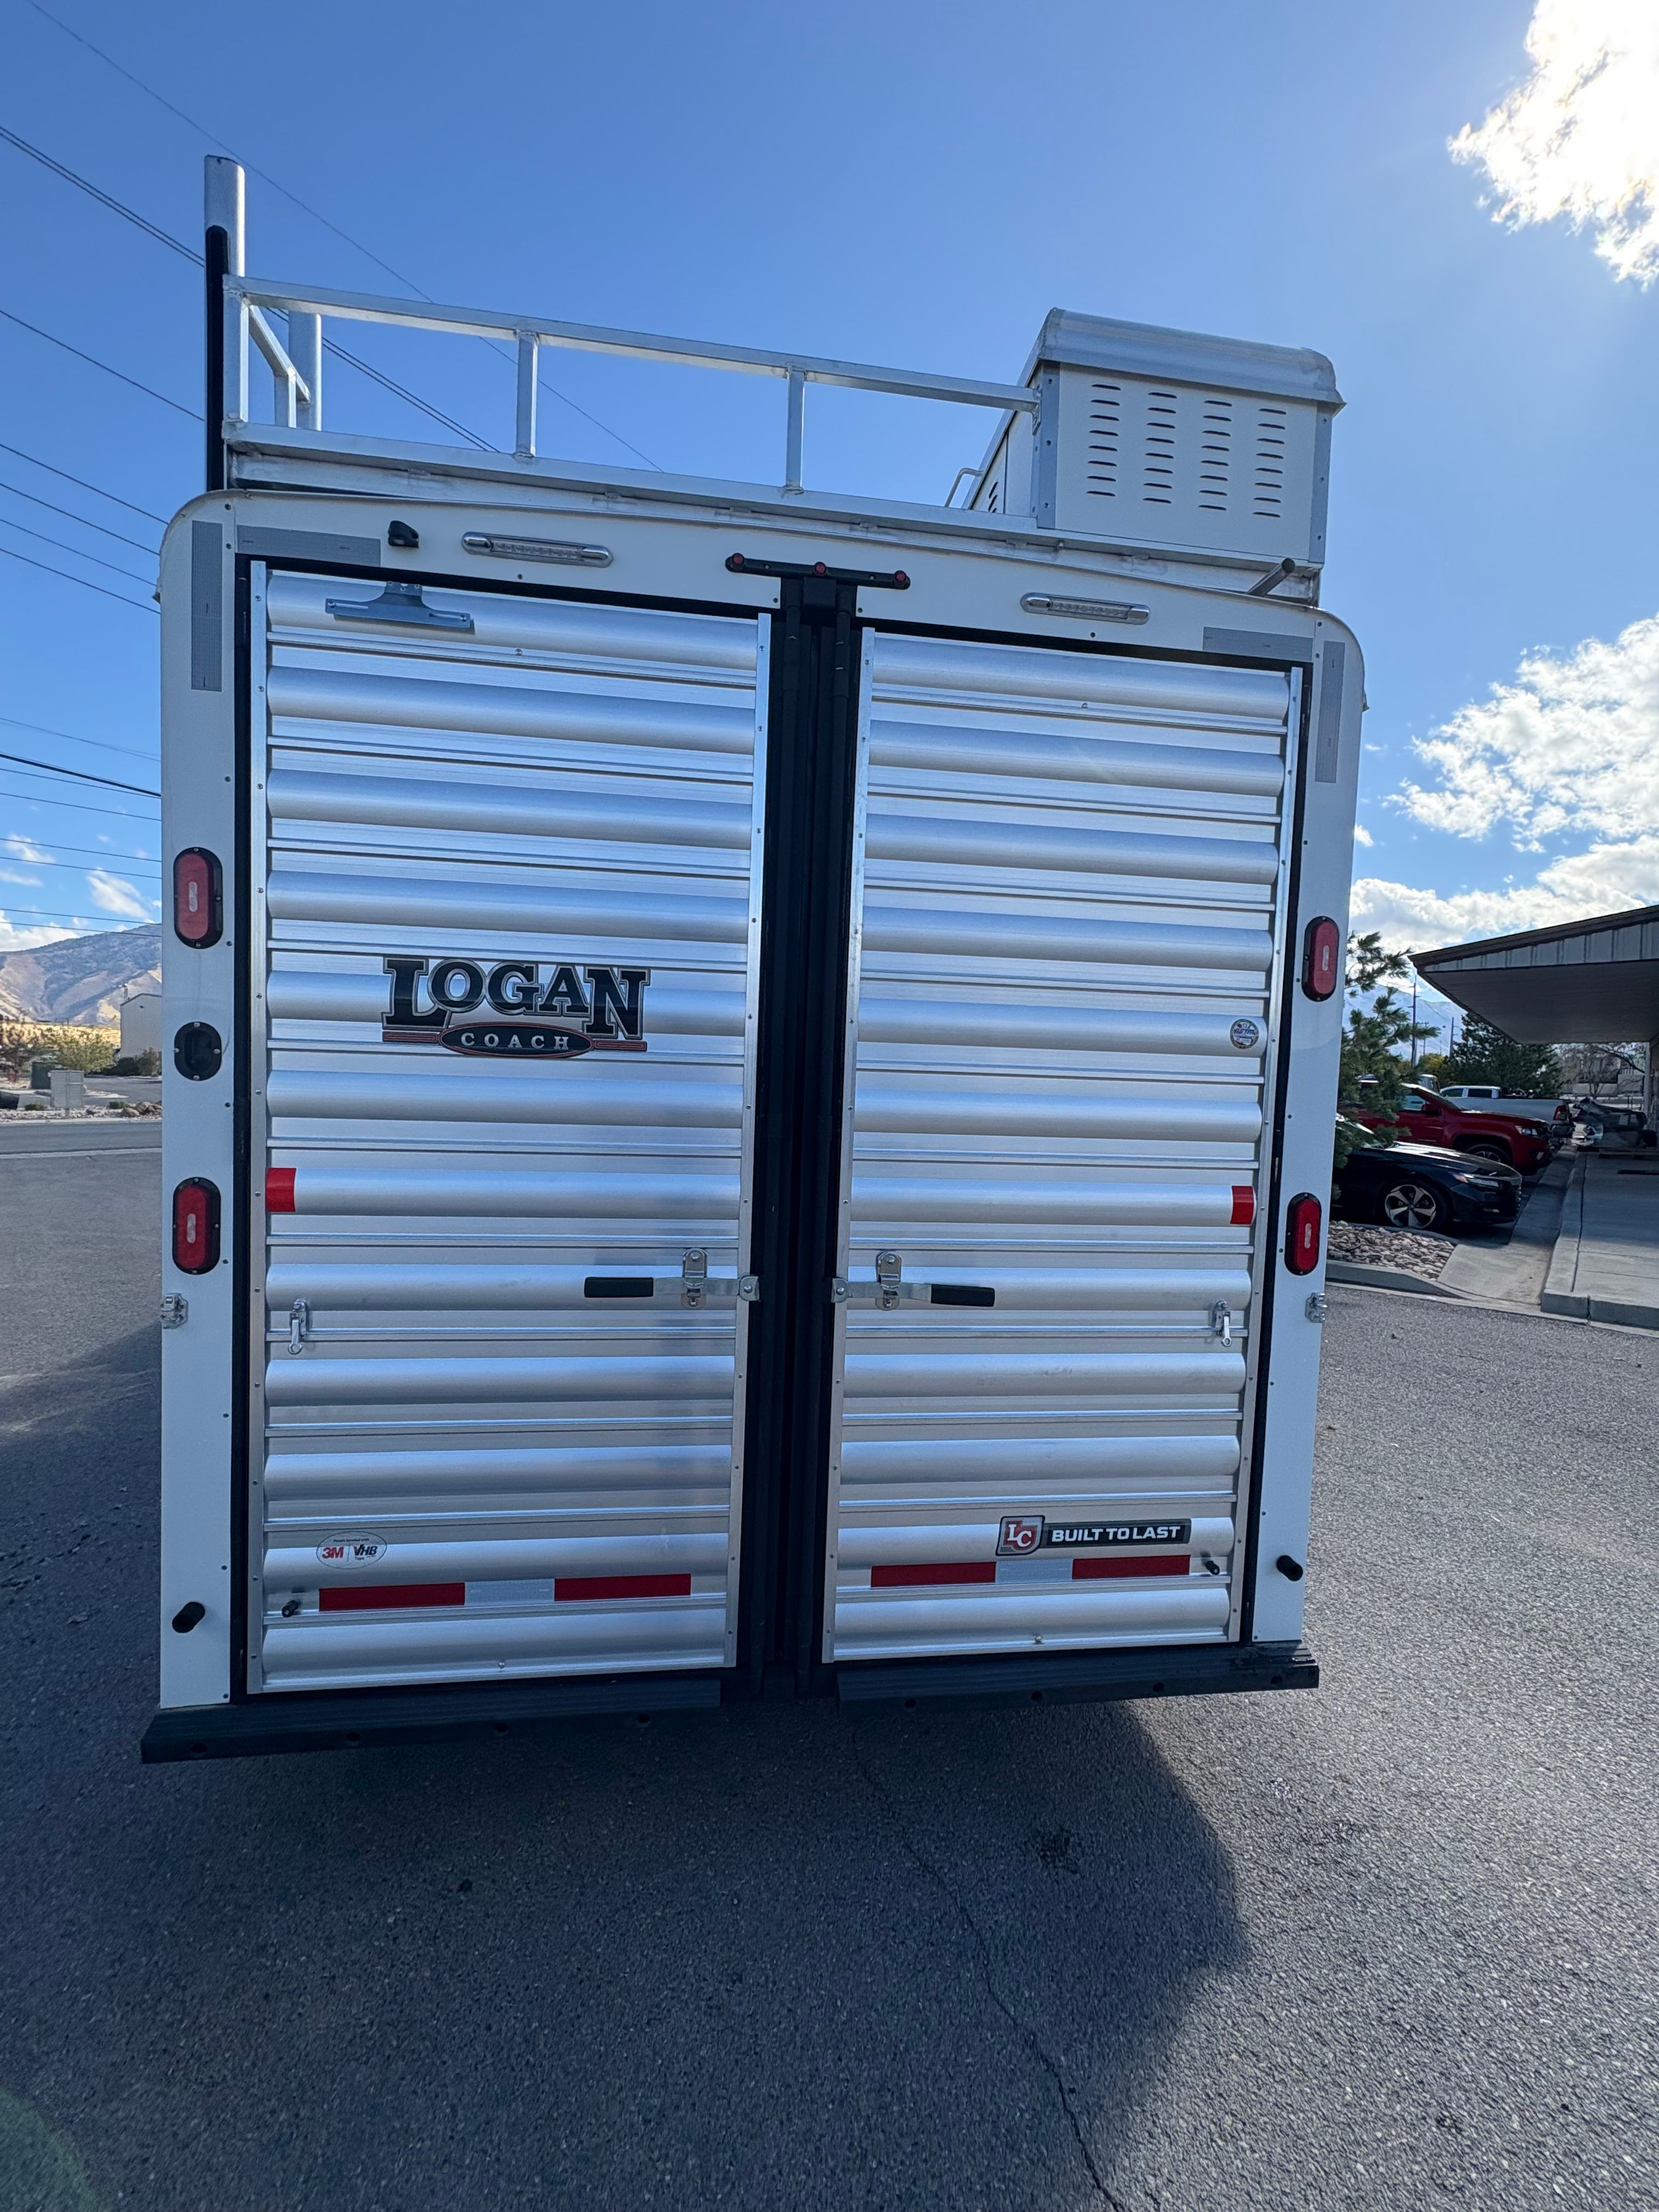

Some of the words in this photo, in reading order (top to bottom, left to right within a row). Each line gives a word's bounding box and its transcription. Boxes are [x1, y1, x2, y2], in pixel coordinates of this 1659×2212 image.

[382, 957, 651, 1039] LOGAN
[461, 1032, 569, 1050] COACH
[1007, 1524, 1032, 1548] LC
[1052, 1528, 1104, 1543] BUILT
[1105, 1528, 1130, 1540] TO
[1131, 1526, 1181, 1539] LAST
[321, 1547, 344, 1559] 3M
[353, 1544, 377, 1556] VHB
